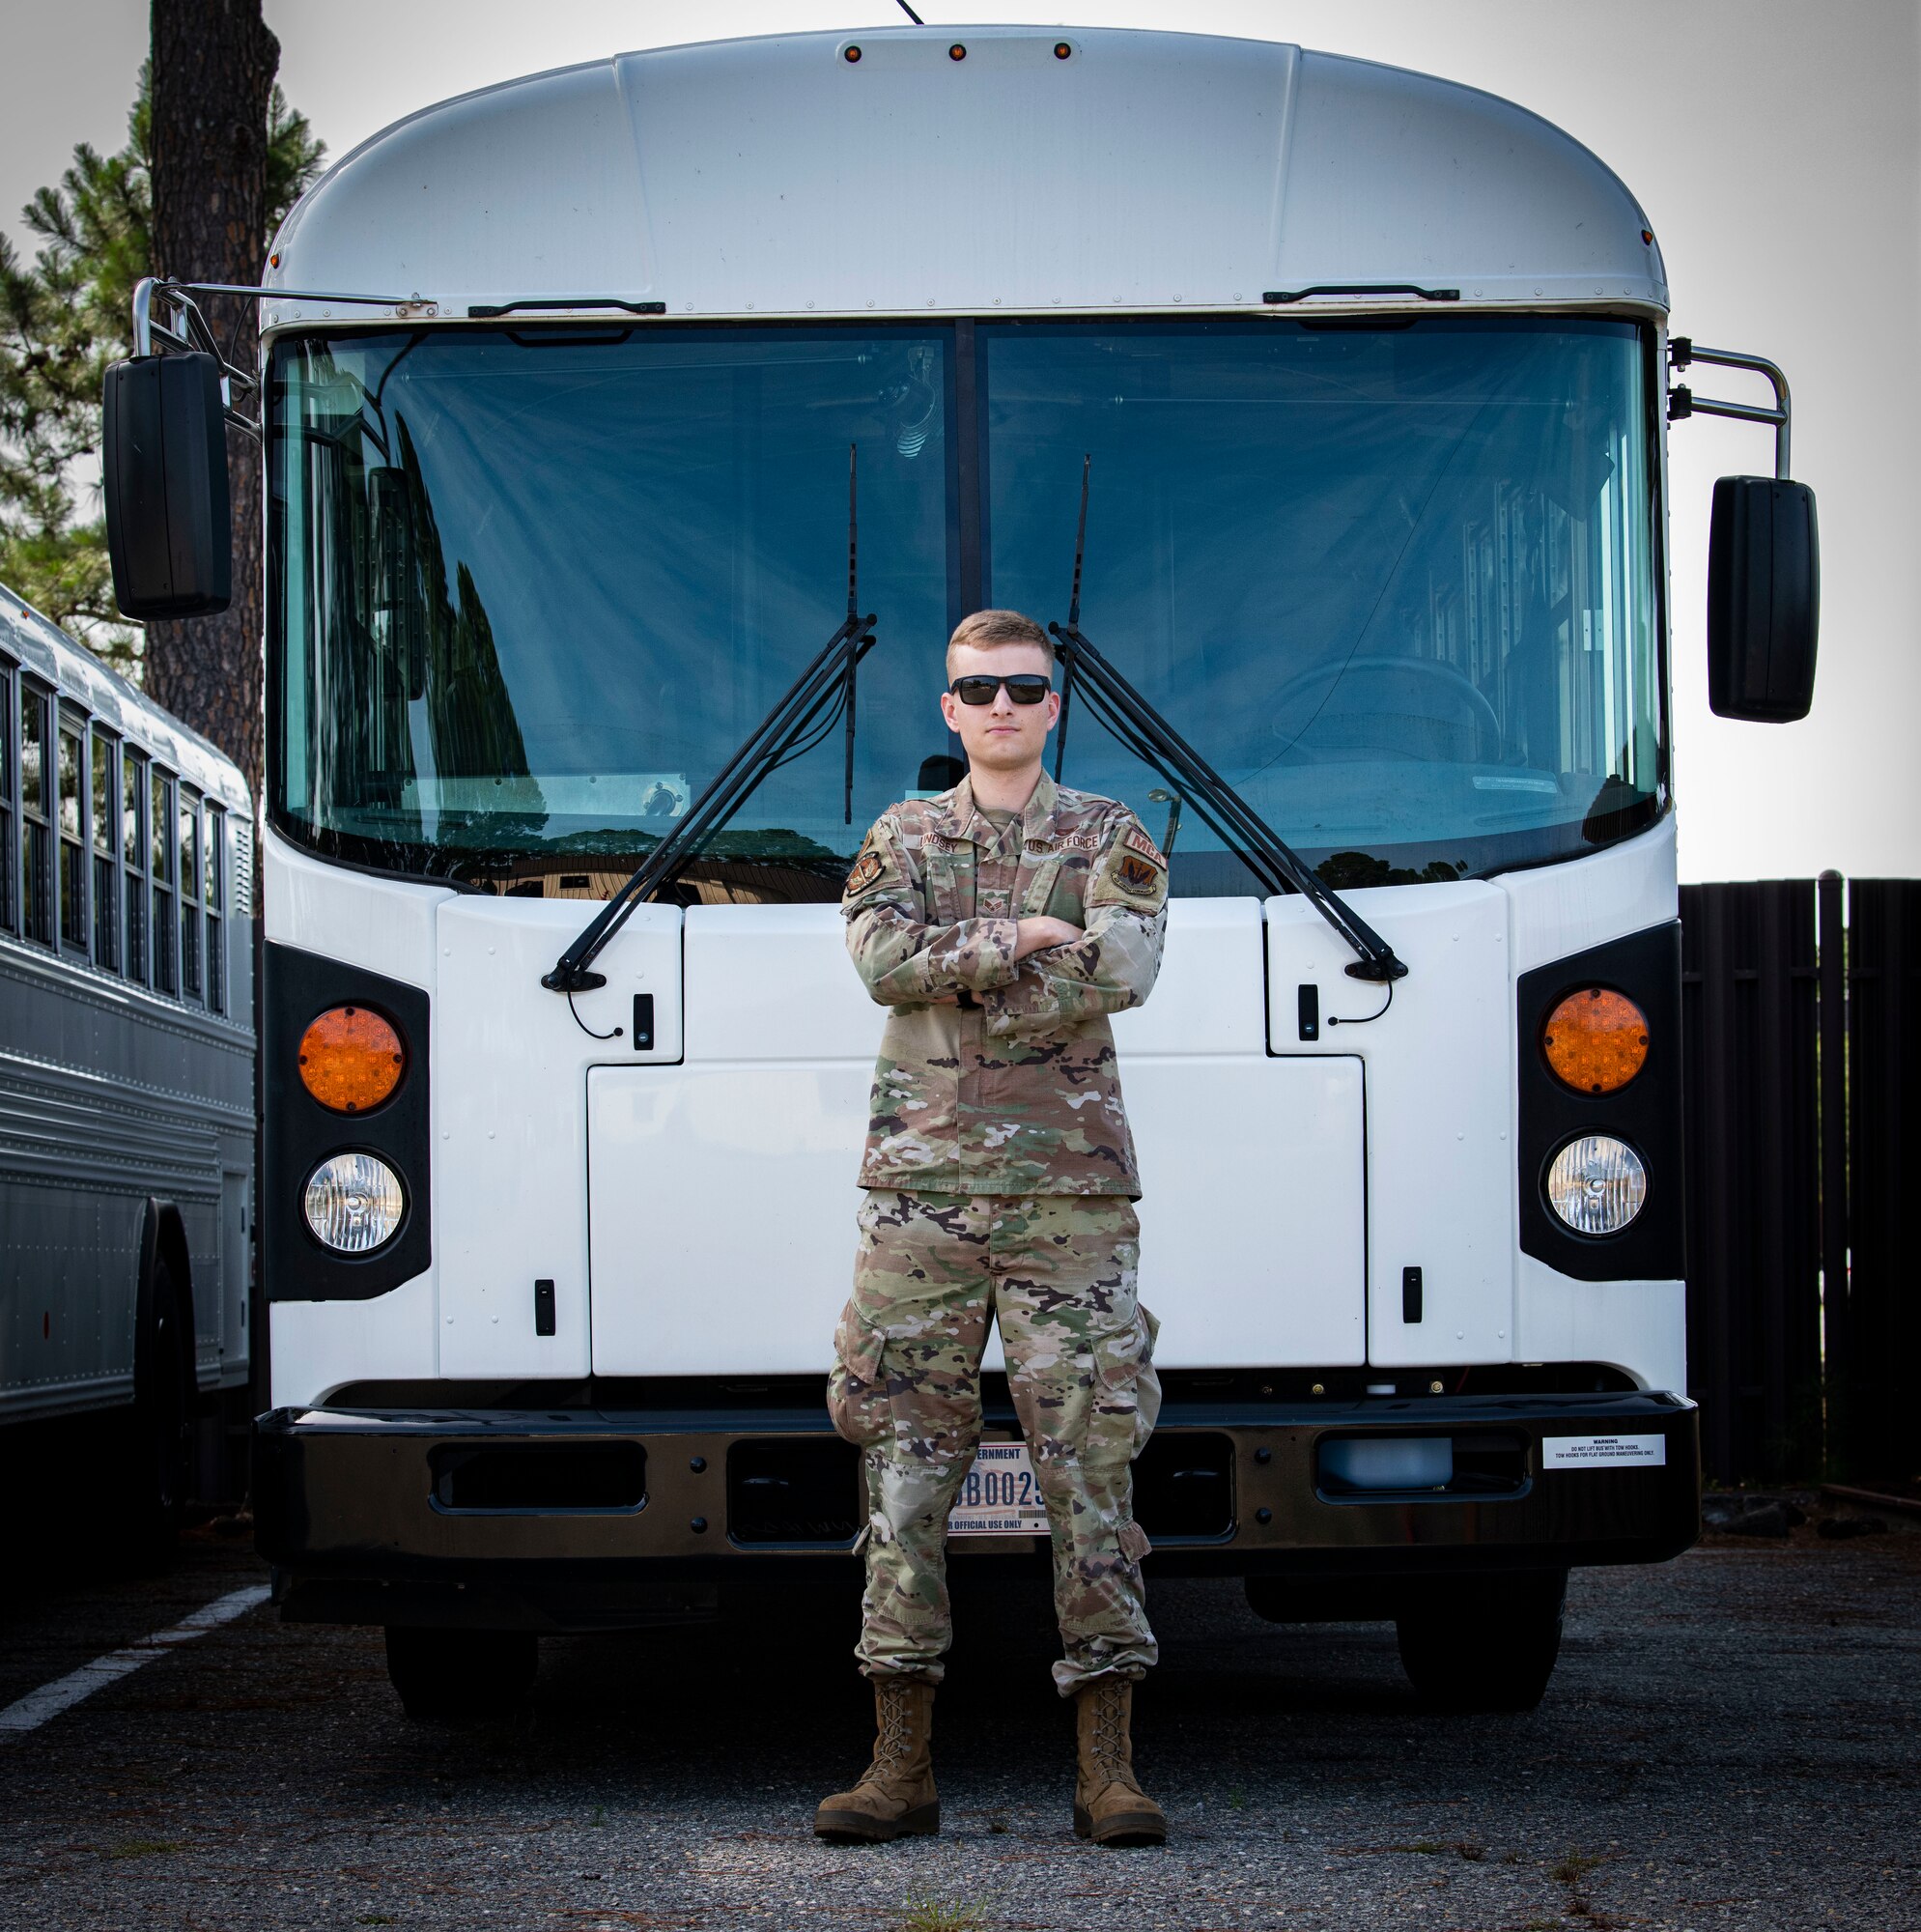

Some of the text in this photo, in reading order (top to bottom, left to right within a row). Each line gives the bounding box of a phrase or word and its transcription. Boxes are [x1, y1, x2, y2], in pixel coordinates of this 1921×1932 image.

[1048, 840, 1064, 853] AIR
[1066, 836, 1098, 849] FORCE
[1131, 835, 1163, 866] MCA
[954, 1520, 986, 1530] OFFICIAL
[988, 1520, 1003, 1529] USE
[1004, 1520, 1023, 1529] ONLY
